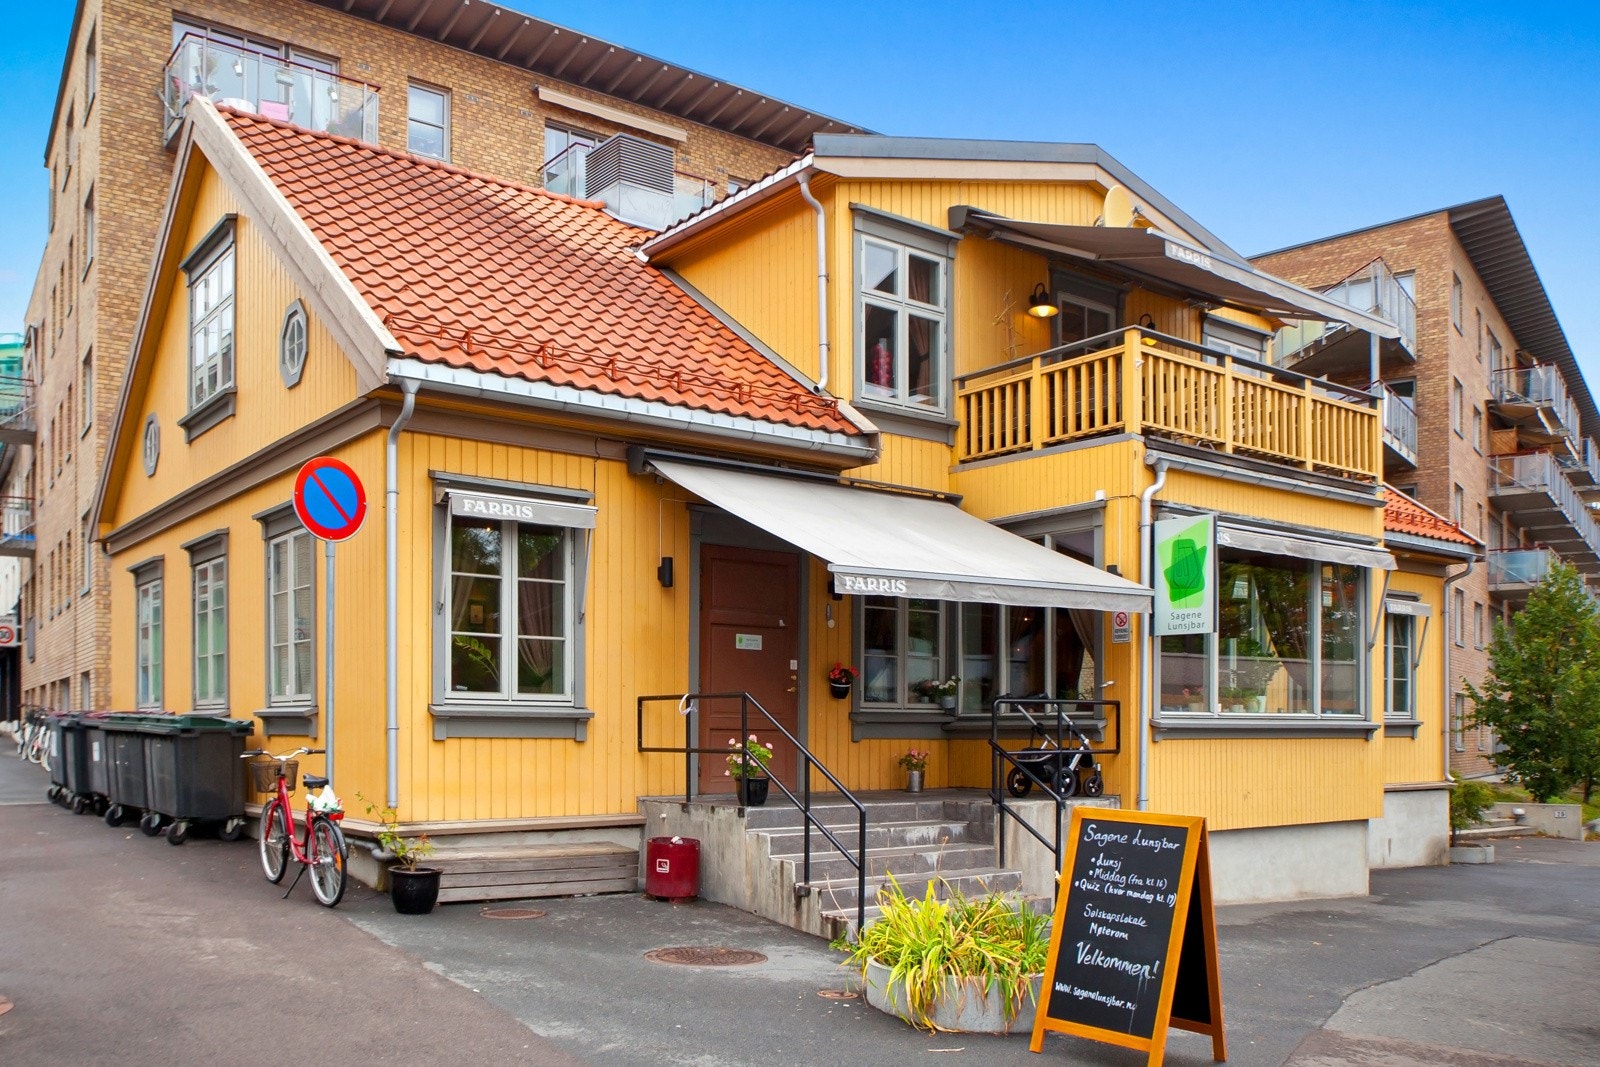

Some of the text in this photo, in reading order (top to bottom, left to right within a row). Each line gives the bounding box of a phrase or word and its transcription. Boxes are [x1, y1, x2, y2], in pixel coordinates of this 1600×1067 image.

[463, 499, 534, 519] FARRIS
[844, 576, 908, 593] FARRIS
[1167, 621, 1205, 631] Lunsjbar
[1170, 612, 1202, 621] Sagene
[1083, 824, 1180, 852] Sagene Lunsjbar
[1096, 852, 1122, 872] Lunsj
[1079, 878, 1100, 891] Quiz
[1104, 882, 1126, 895] (hver
[1093, 868, 1127, 888] Middag
[1128, 873, 1144, 886] (fra
[1089, 922, 1129, 940] Møterom
[1076, 941, 1160, 979] Velkommen!
